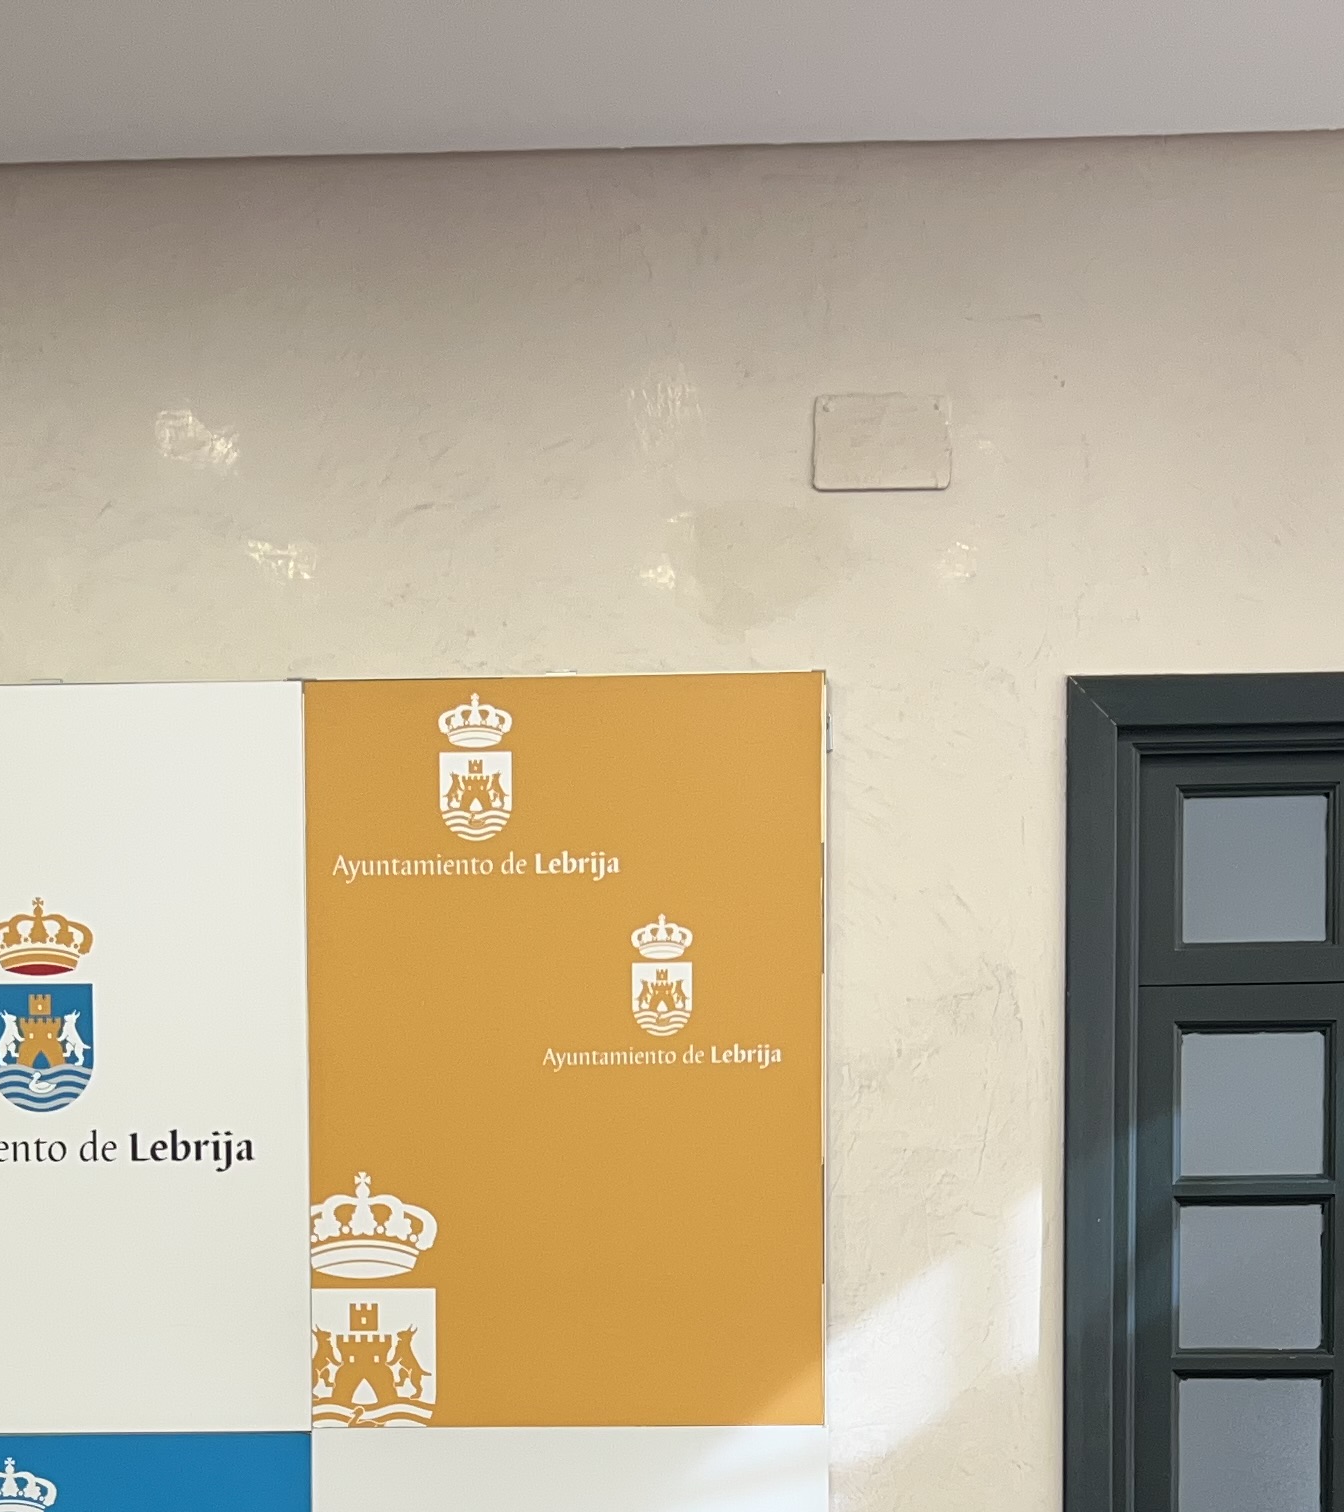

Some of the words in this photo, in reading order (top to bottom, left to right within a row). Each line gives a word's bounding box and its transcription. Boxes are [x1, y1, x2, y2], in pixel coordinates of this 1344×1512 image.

[332, 853, 494, 884] Ayuntamiento
[500, 850, 528, 875] de
[534, 850, 621, 882] Lebrija
[542, 1046, 677, 1073] Ayuntamiento
[682, 1044, 705, 1065] de
[711, 1043, 782, 1070] Lebrija
[79, 1129, 117, 1163] de
[129, 1129, 255, 1173] Lebrija
